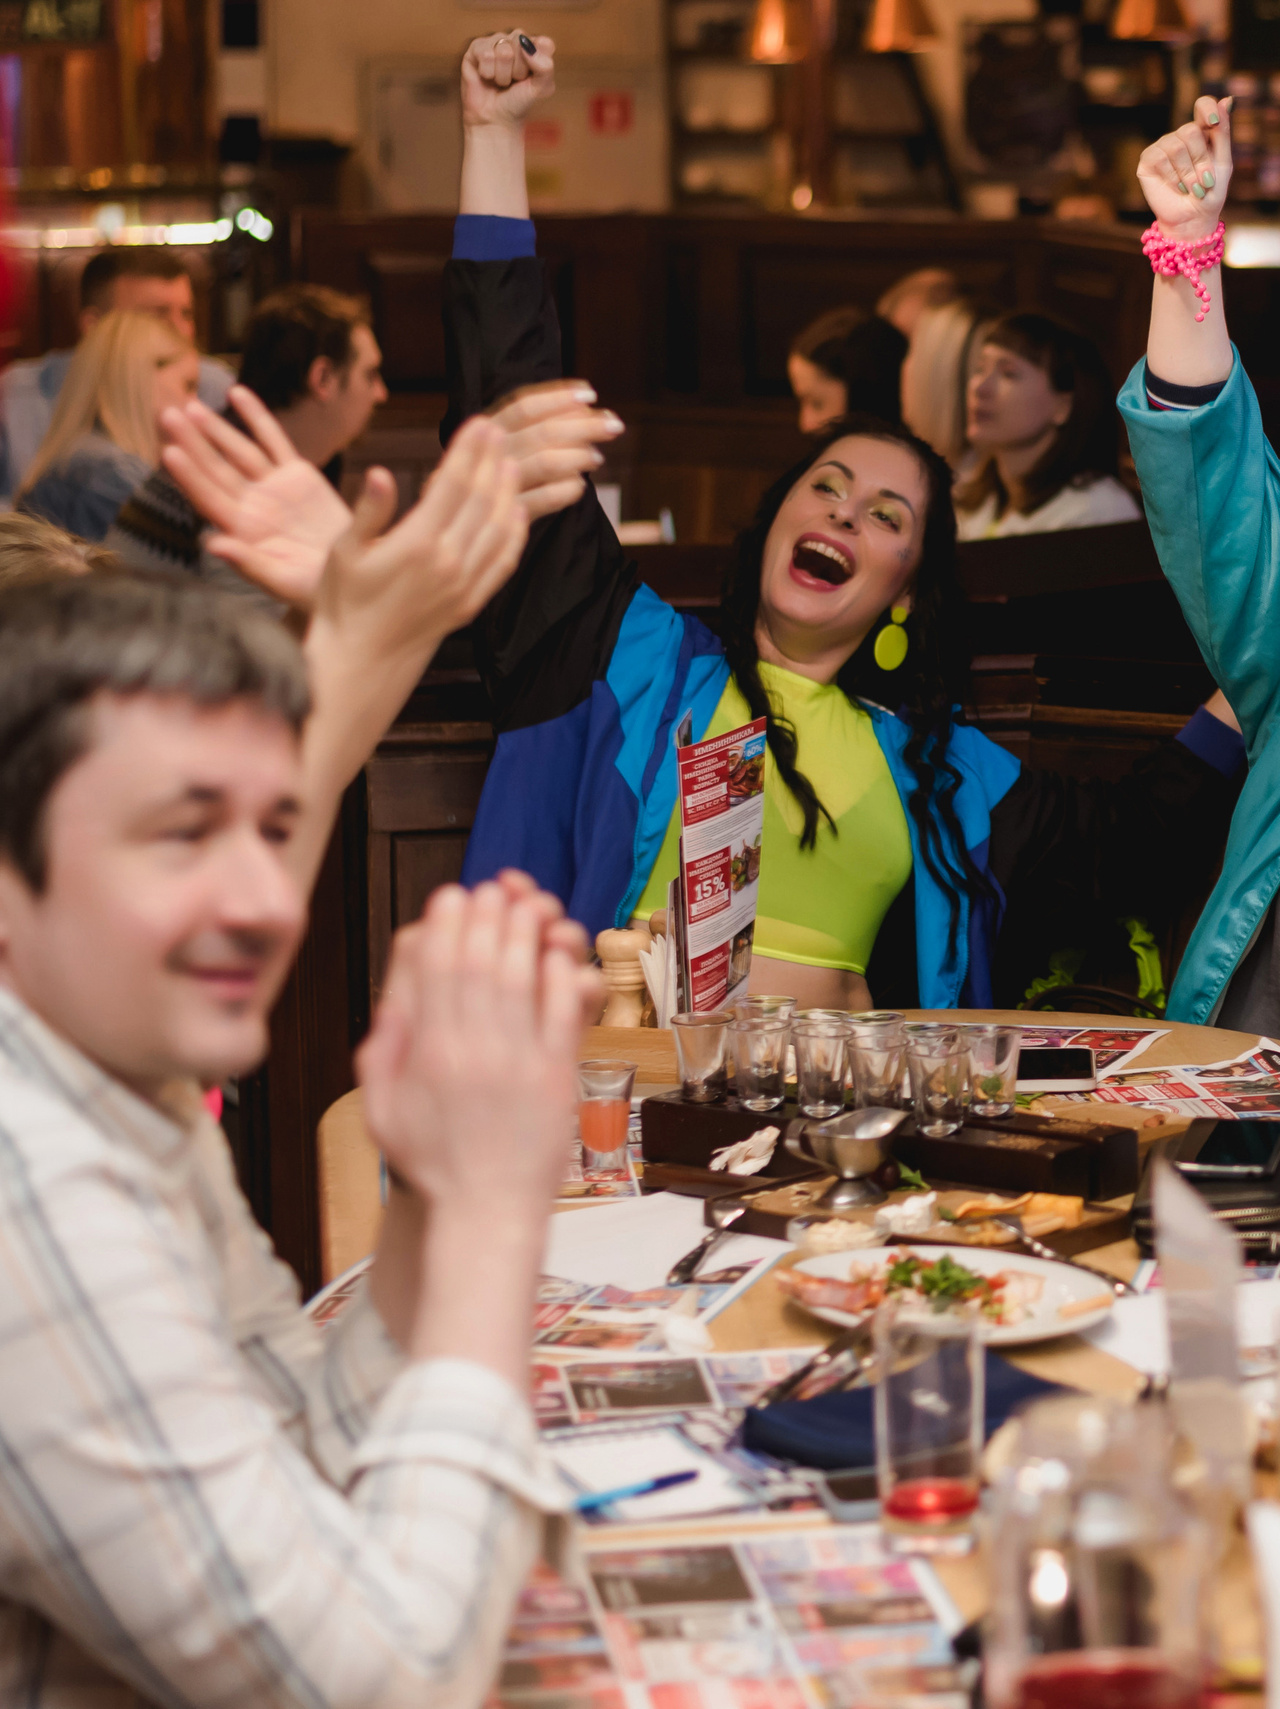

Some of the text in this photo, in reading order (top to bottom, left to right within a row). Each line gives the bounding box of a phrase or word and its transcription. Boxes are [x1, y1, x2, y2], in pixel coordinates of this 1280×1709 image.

[694, 727, 754, 756] ИМЕНИННИКАМ
[684, 760, 727, 780] ИМЕНИННИКУ
[689, 856, 729, 877] ИМЕНИННИКУ
[695, 874, 725, 901] 15%
